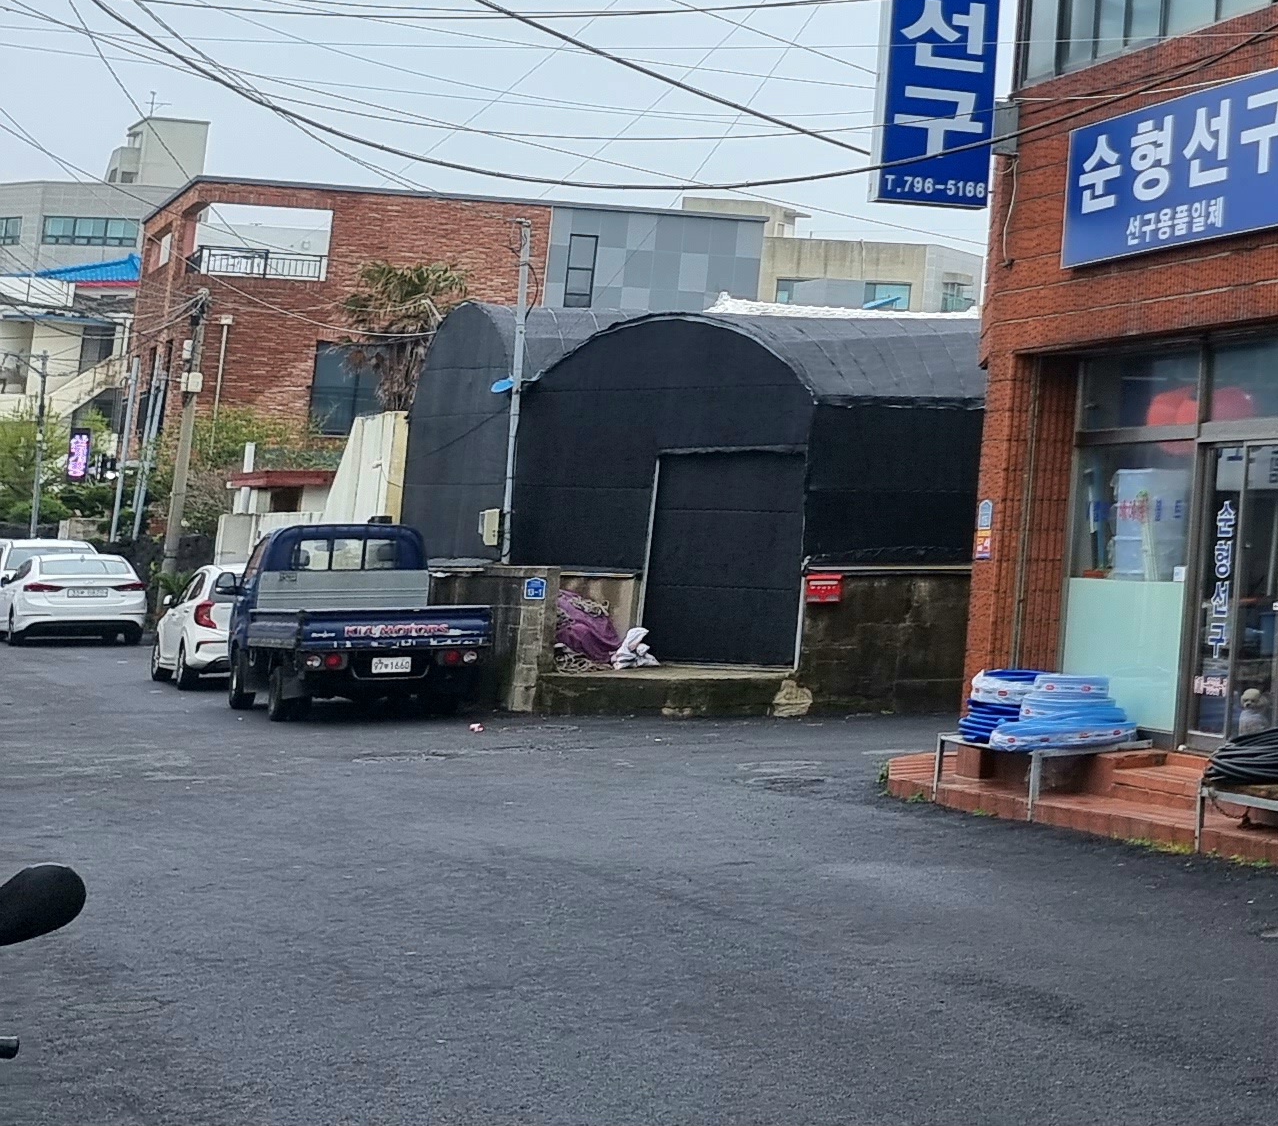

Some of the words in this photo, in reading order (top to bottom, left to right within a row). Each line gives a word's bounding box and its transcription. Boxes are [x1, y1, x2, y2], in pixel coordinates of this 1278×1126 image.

[885, 174, 986, 199] T.796-5166
[1126, 195, 1224, 247] 선구용품일체
[1208, 500, 1236, 659] 순형선구
